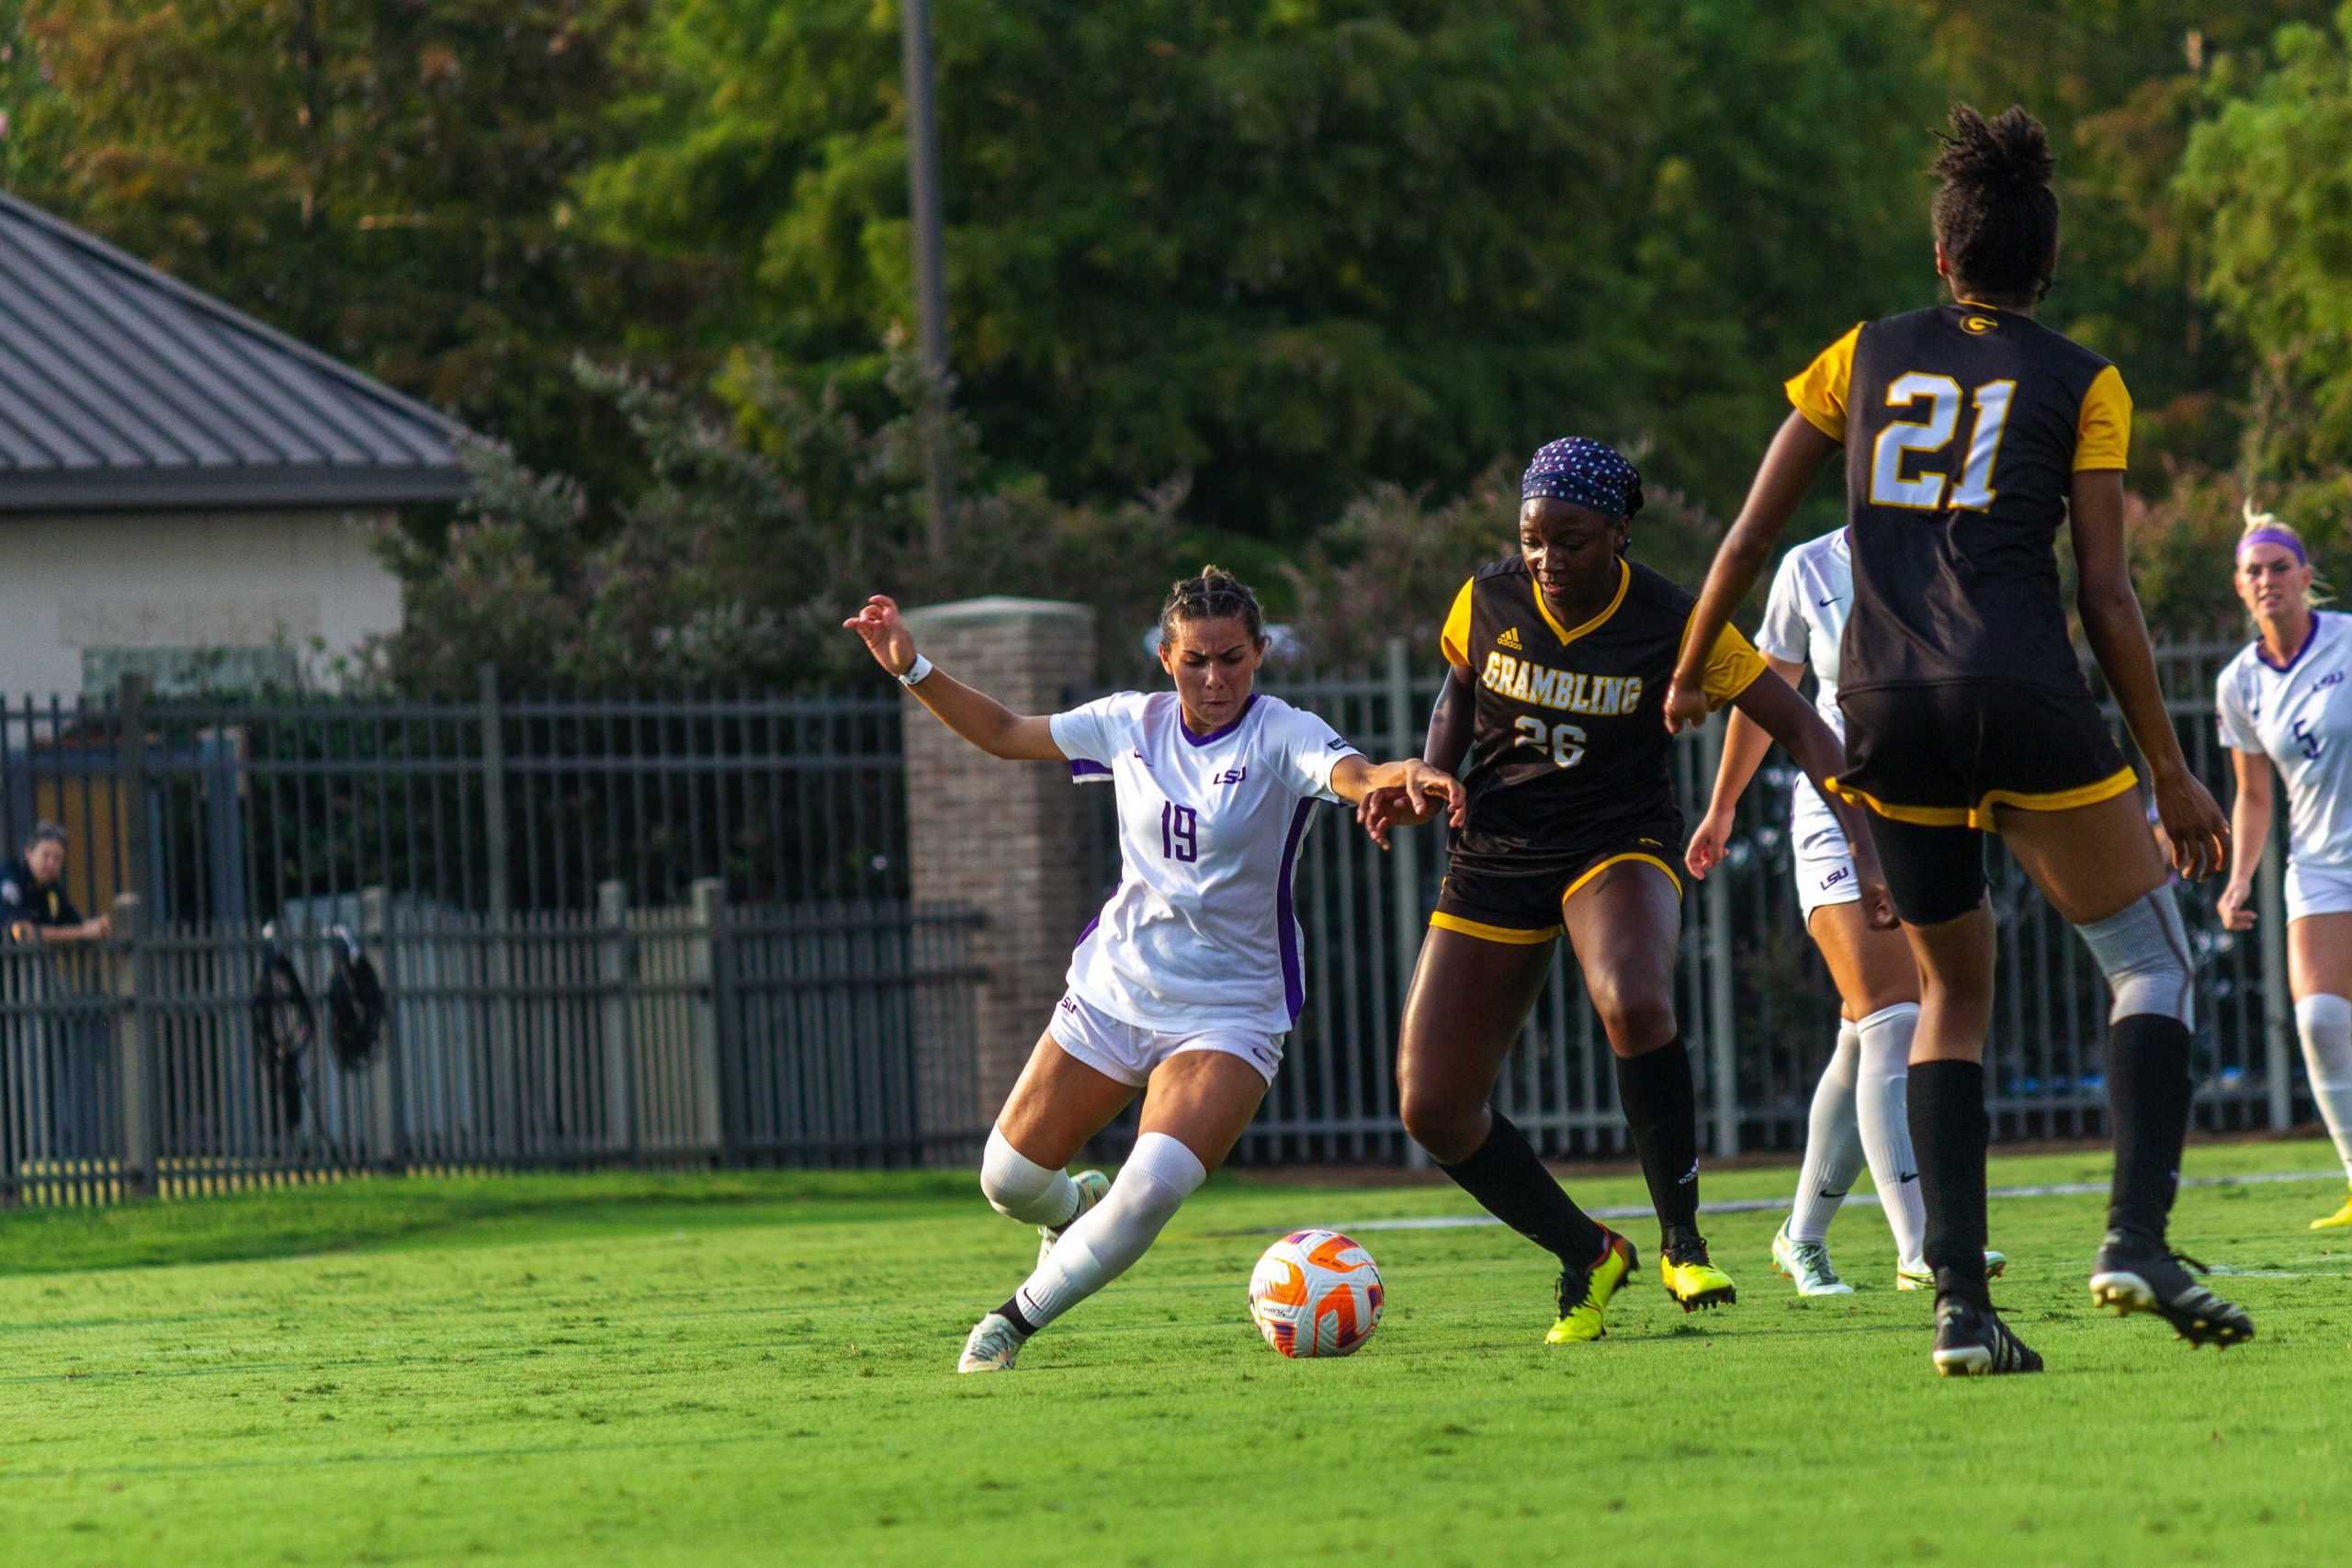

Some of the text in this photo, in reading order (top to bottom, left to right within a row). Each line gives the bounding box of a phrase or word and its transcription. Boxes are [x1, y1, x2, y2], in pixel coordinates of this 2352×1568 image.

[1869, 371, 2017, 513] 21
[1482, 650, 1643, 716] GRAMBLING
[1515, 715, 1588, 768] 26
[2293, 718, 2321, 760] 5
[1213, 766, 1247, 784] LSU
[1161, 800, 1197, 863] 19
[1820, 866, 1849, 891] LSU
[1060, 996, 1078, 1014] SU
